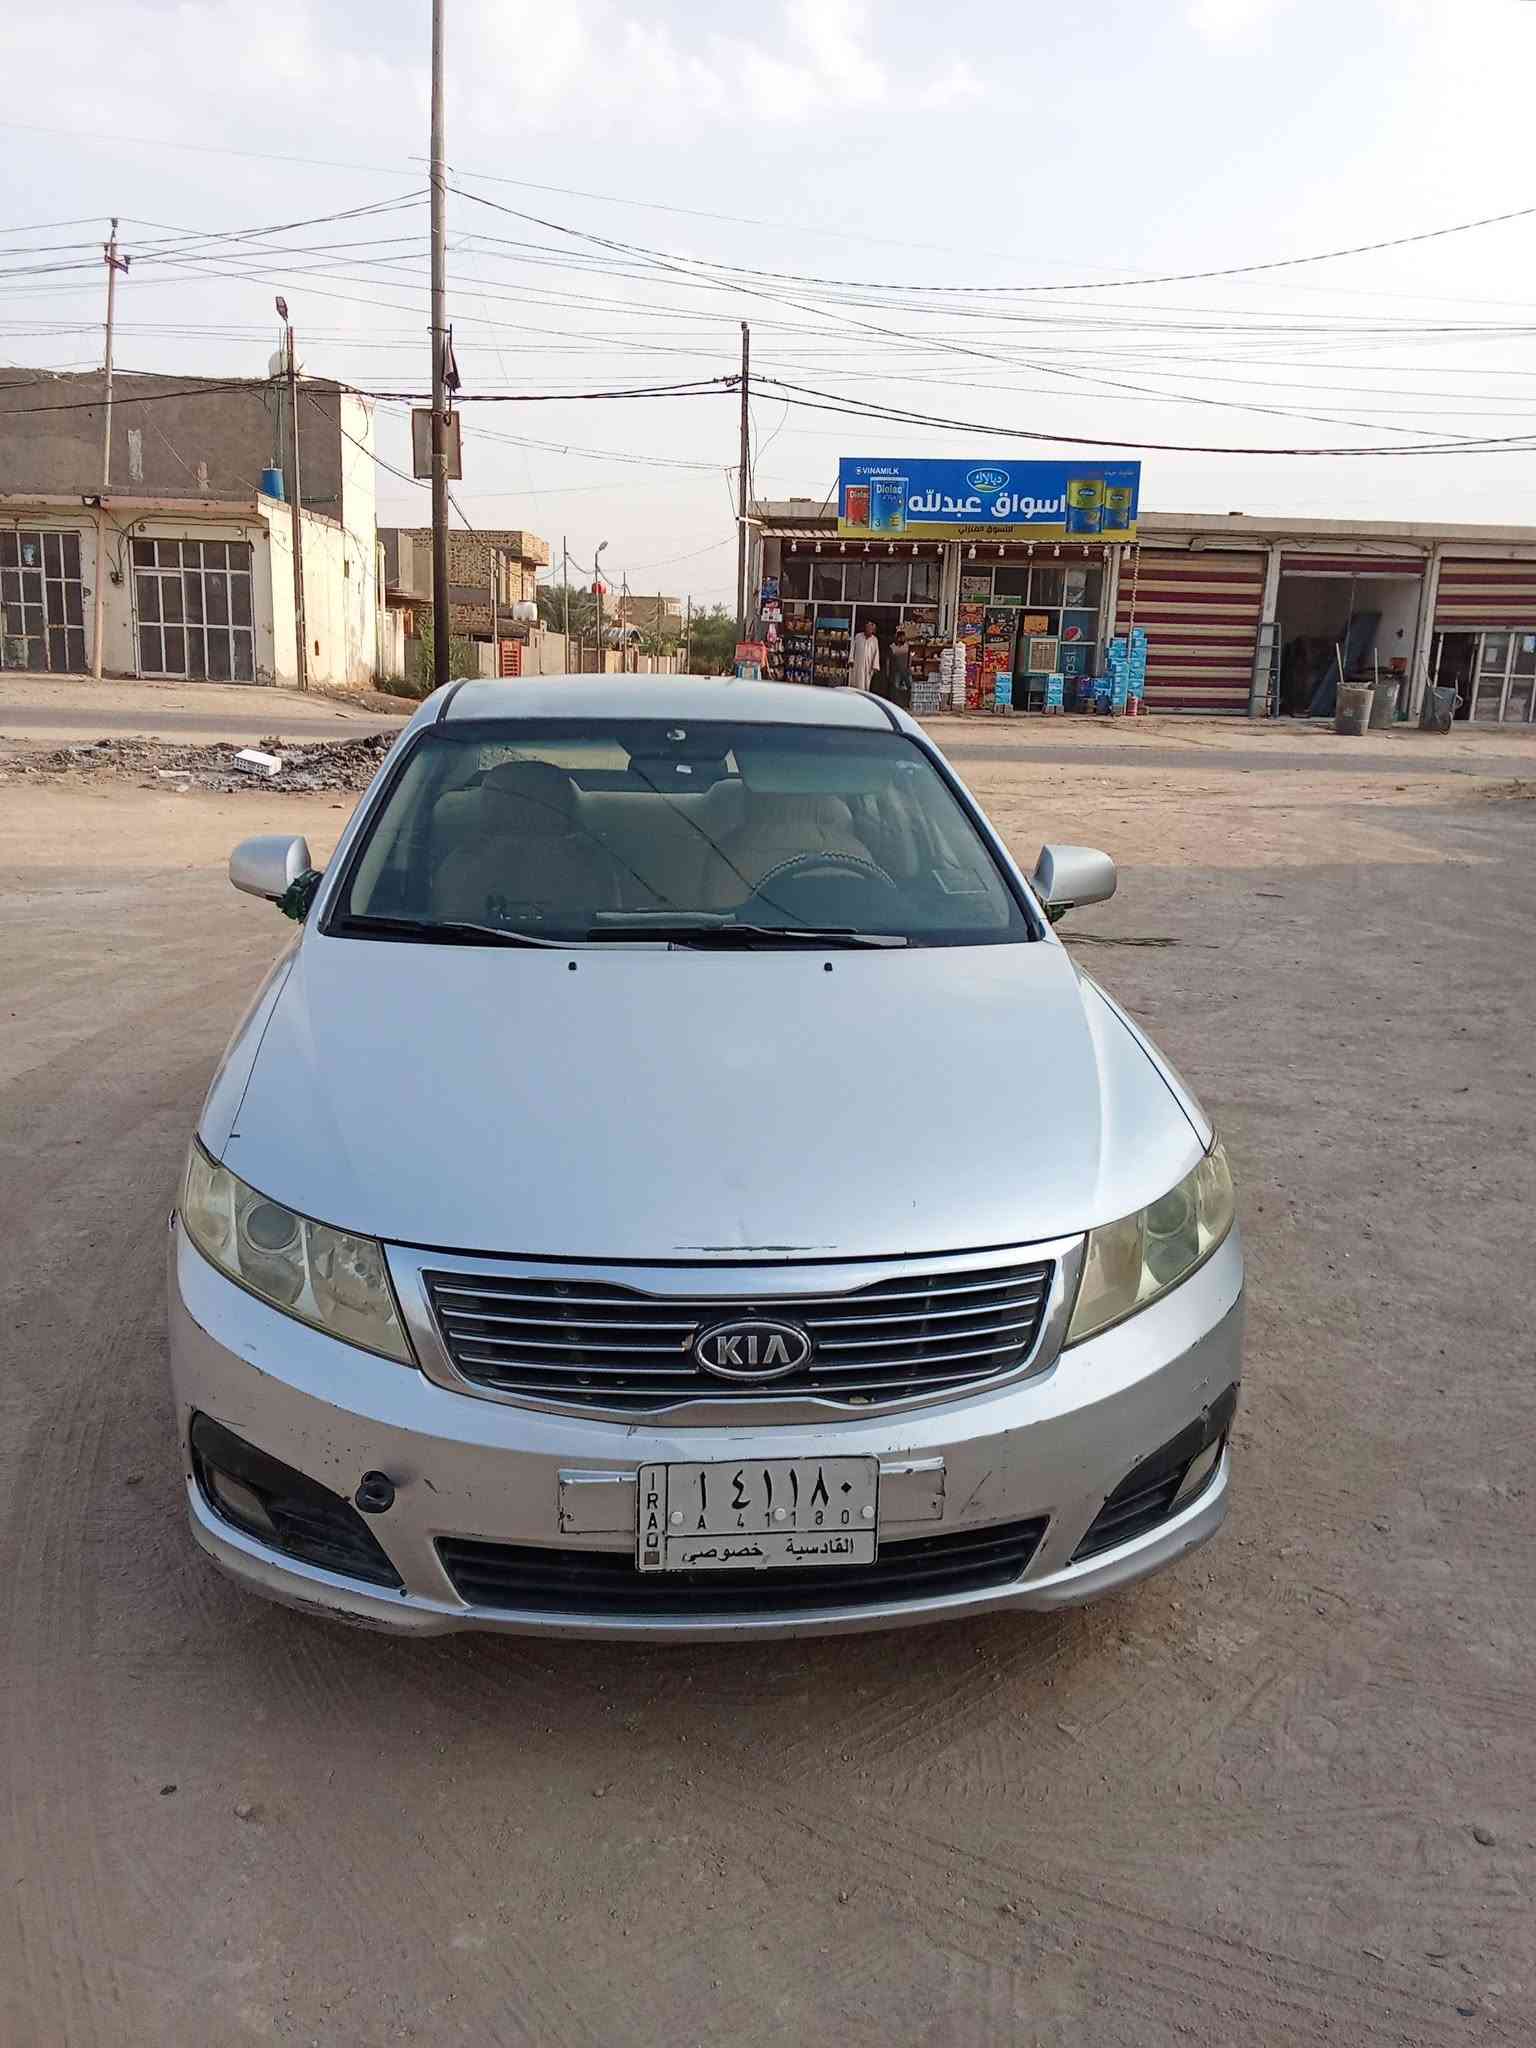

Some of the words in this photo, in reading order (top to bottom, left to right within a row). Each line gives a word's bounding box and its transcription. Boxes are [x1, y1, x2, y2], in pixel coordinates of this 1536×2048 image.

[863, 467, 900, 475] VINAMILK
[990, 492, 1066, 518] اسواق
[716, 1334, 791, 1365] KIA
[681, 1542, 764, 1565] خصوصي
[785, 1538, 855, 1561] القادسية
